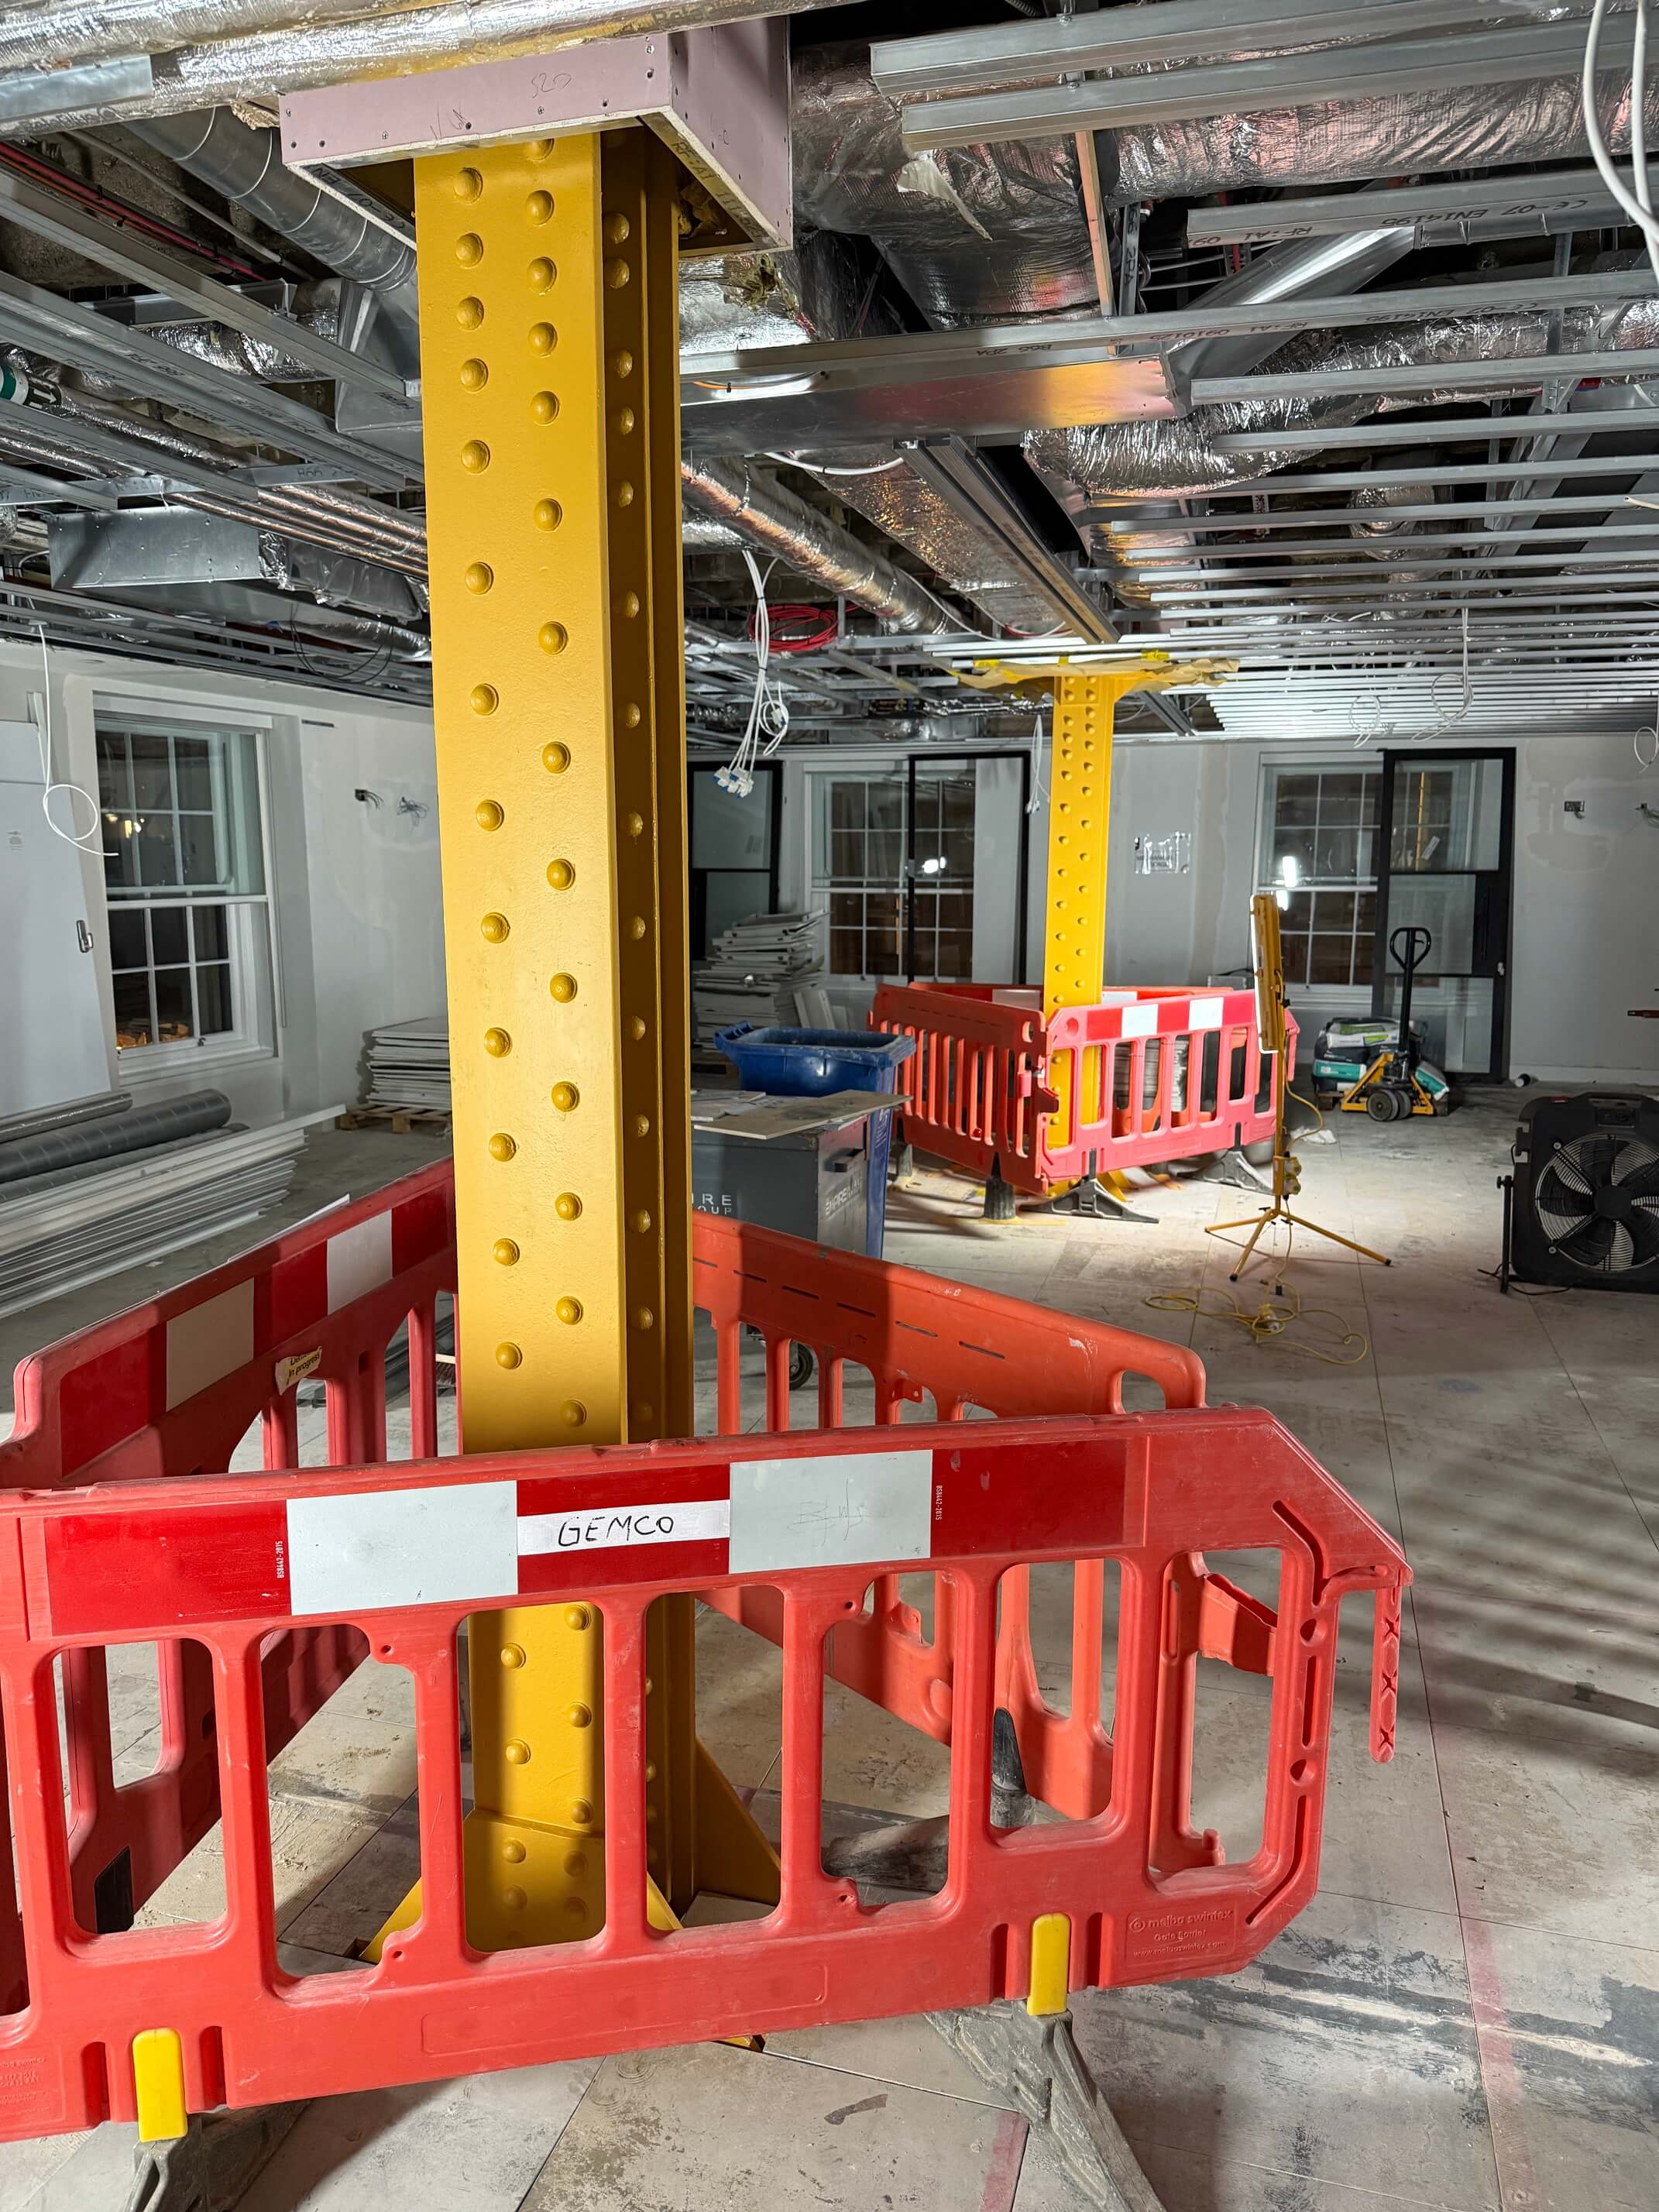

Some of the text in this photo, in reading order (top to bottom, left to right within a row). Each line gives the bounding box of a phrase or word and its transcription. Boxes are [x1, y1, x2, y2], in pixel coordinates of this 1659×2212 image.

[1379, 208, 1489, 228] EN14195
[935, 1485, 943, 1520] BS8442-2015
[558, 1515, 674, 1547] GEMCO
[275, 1540, 285, 1578] BS8442-2015
